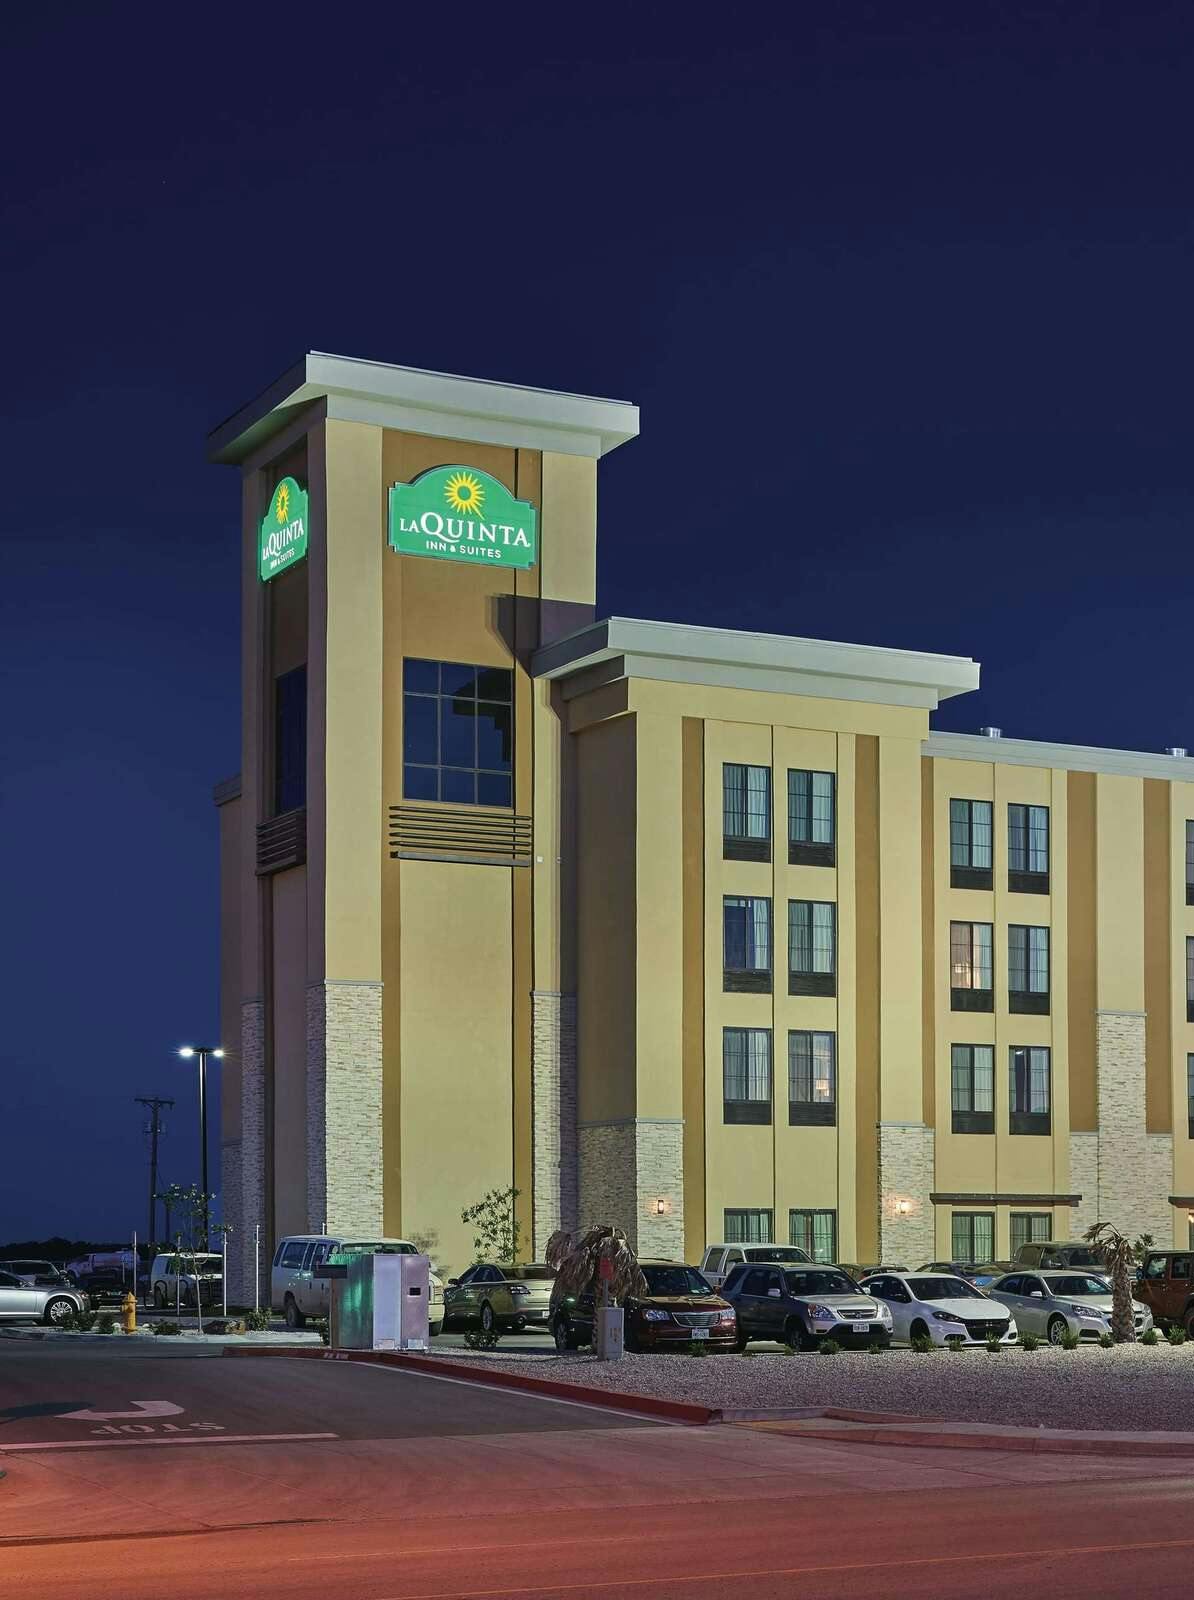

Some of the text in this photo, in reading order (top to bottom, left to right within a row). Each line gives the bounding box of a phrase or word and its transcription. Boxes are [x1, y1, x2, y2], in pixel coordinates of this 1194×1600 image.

[420, 512, 531, 548] QUINTA
[425, 540, 447, 552] INN
[459, 545, 502, 559] SUITES
[89, 1422, 225, 1435] STOP
